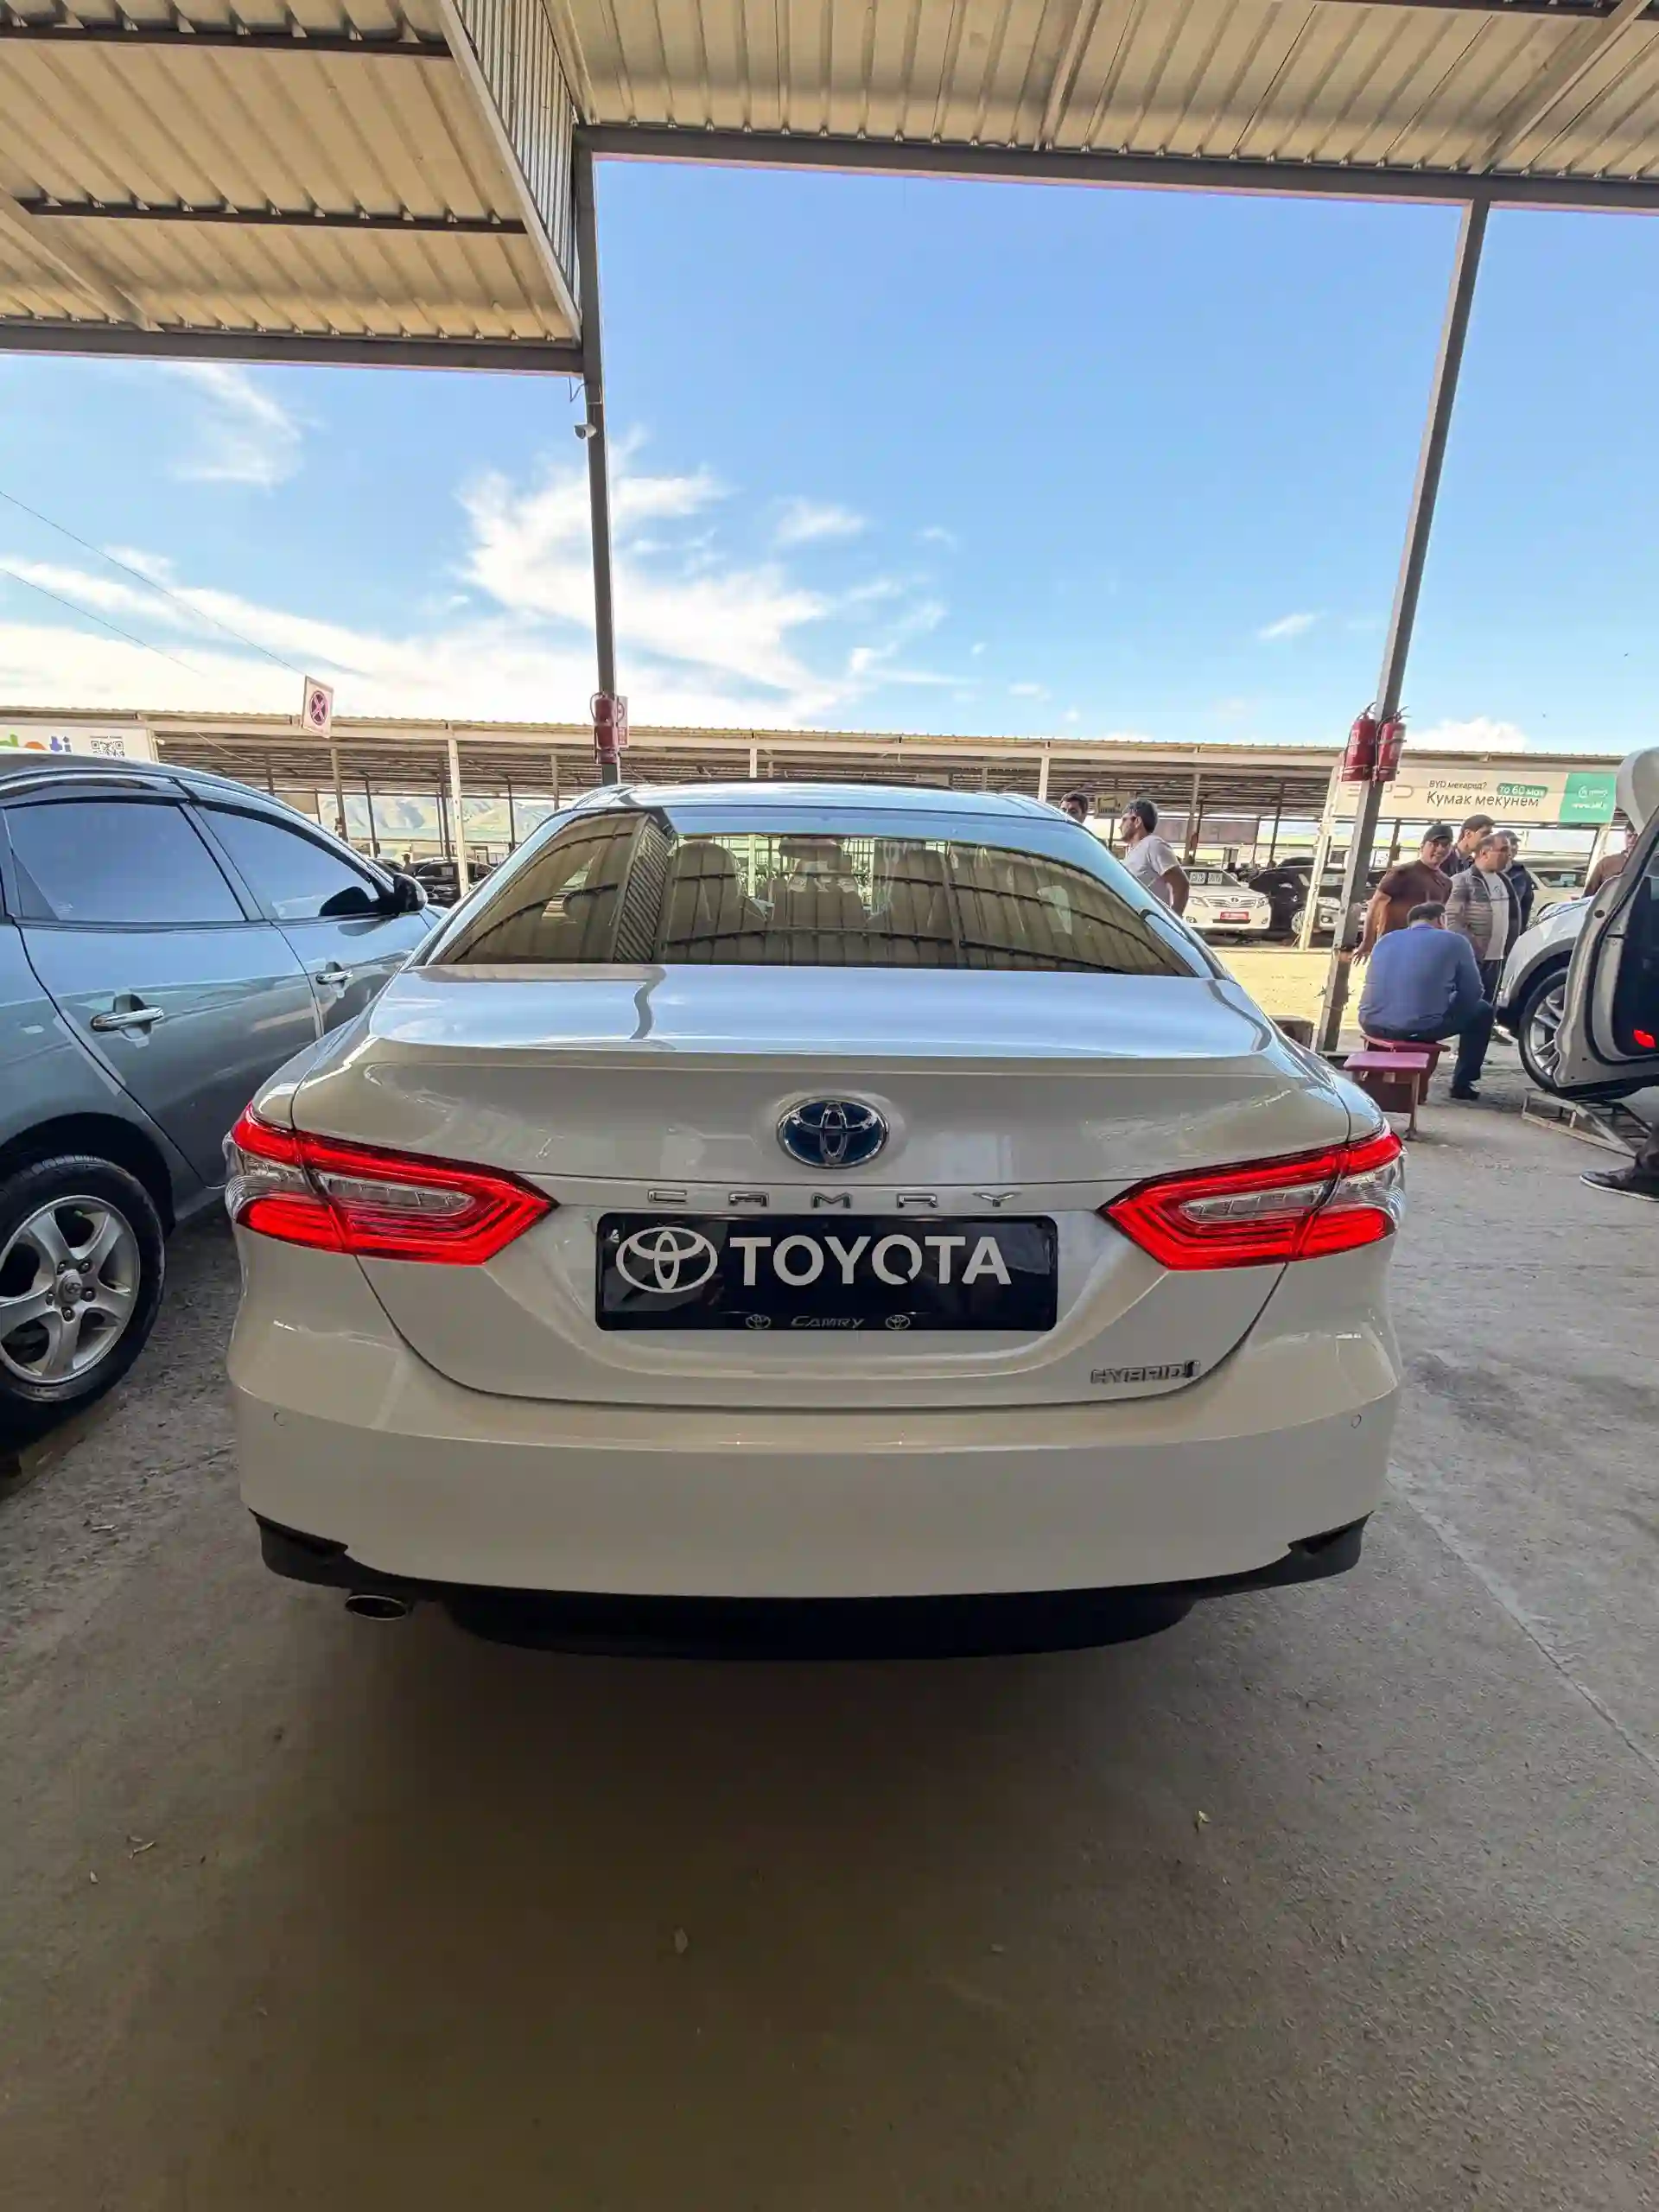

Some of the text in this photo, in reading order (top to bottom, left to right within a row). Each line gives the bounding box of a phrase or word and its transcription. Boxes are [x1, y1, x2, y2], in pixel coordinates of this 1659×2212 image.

[1427, 791, 1539, 809] Кумак мекунем
[1511, 785, 1526, 795] 60
[647, 1188, 1021, 1209] CAMRY
[729, 1234, 1013, 1287] TOYOTA
[1090, 1363, 1183, 1383] HYBRID
